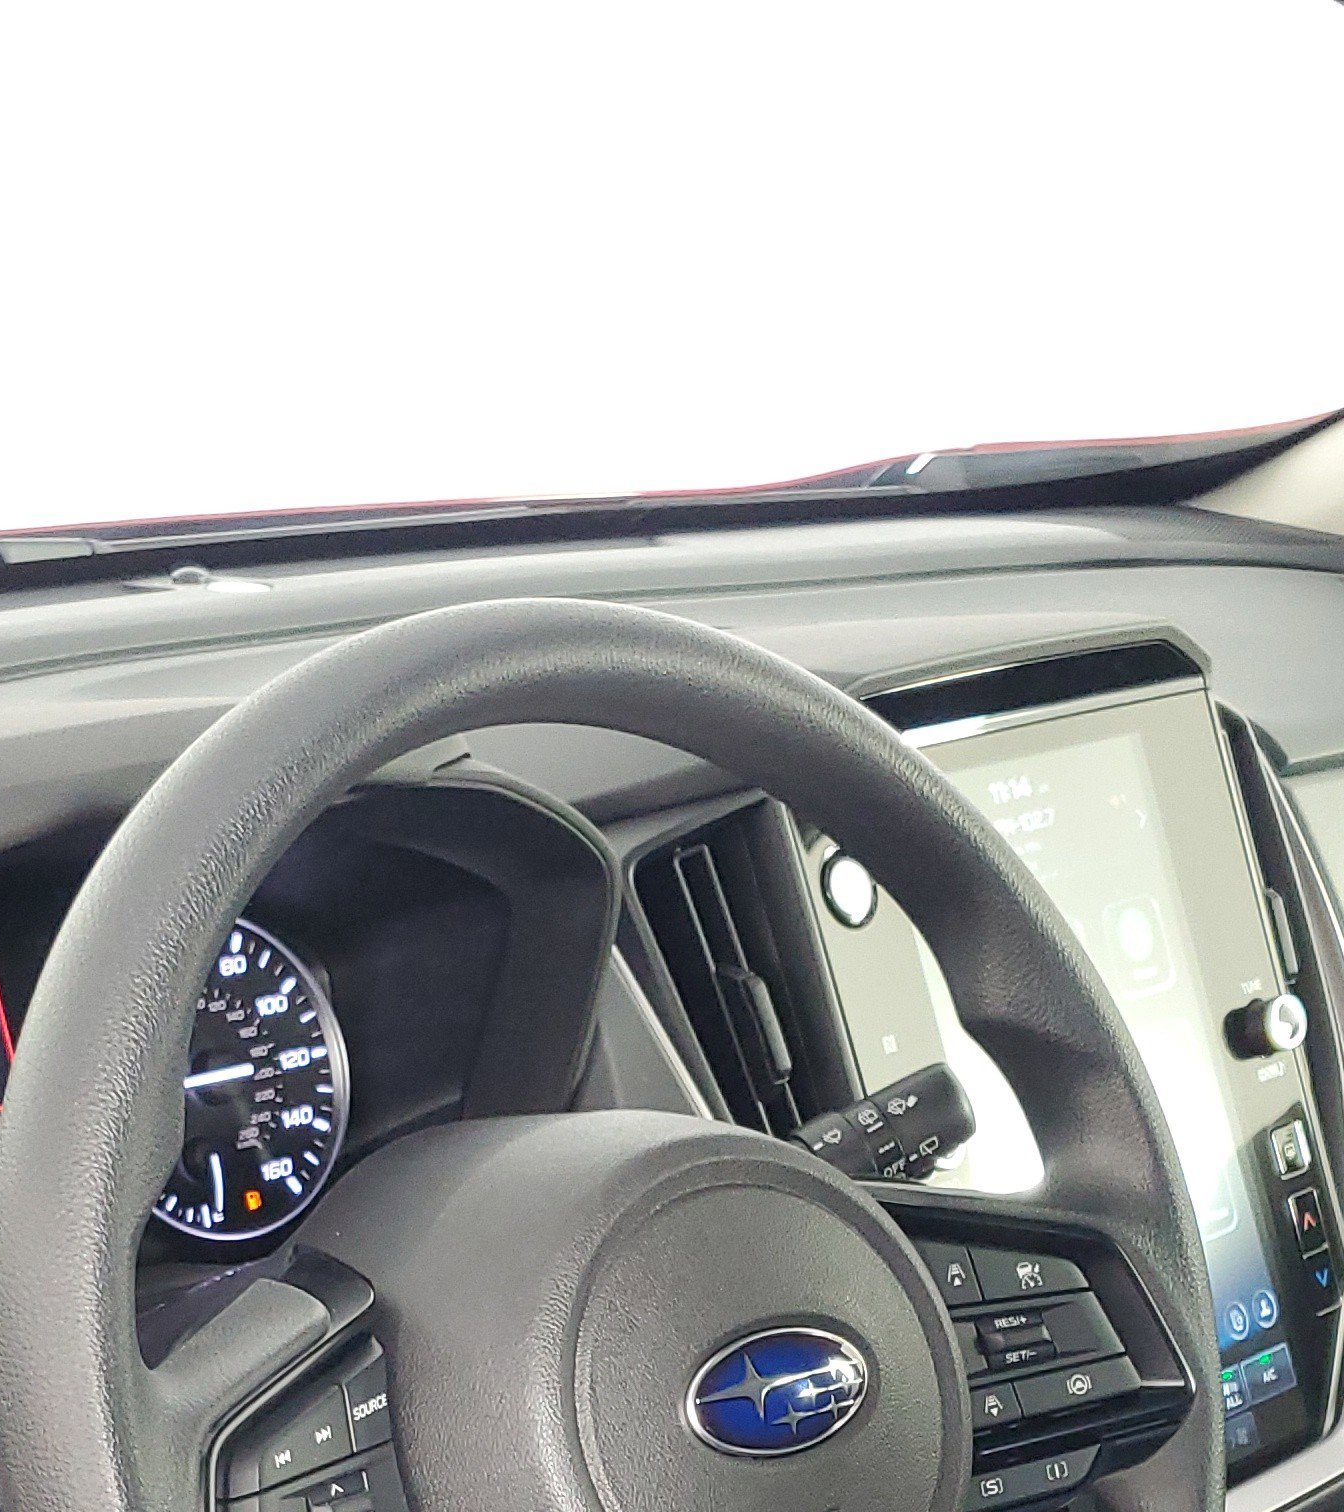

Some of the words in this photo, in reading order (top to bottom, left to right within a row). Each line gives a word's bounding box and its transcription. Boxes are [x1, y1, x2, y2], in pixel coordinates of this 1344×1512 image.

[219, 954, 247, 976] 80
[256, 994, 288, 1016] 100
[279, 1047, 310, 1070] 120
[281, 1104, 314, 1129] 140
[261, 1157, 293, 1181] 160
[883, 1157, 906, 1178] OFF
[352, 1393, 388, 1421] SOURCE
